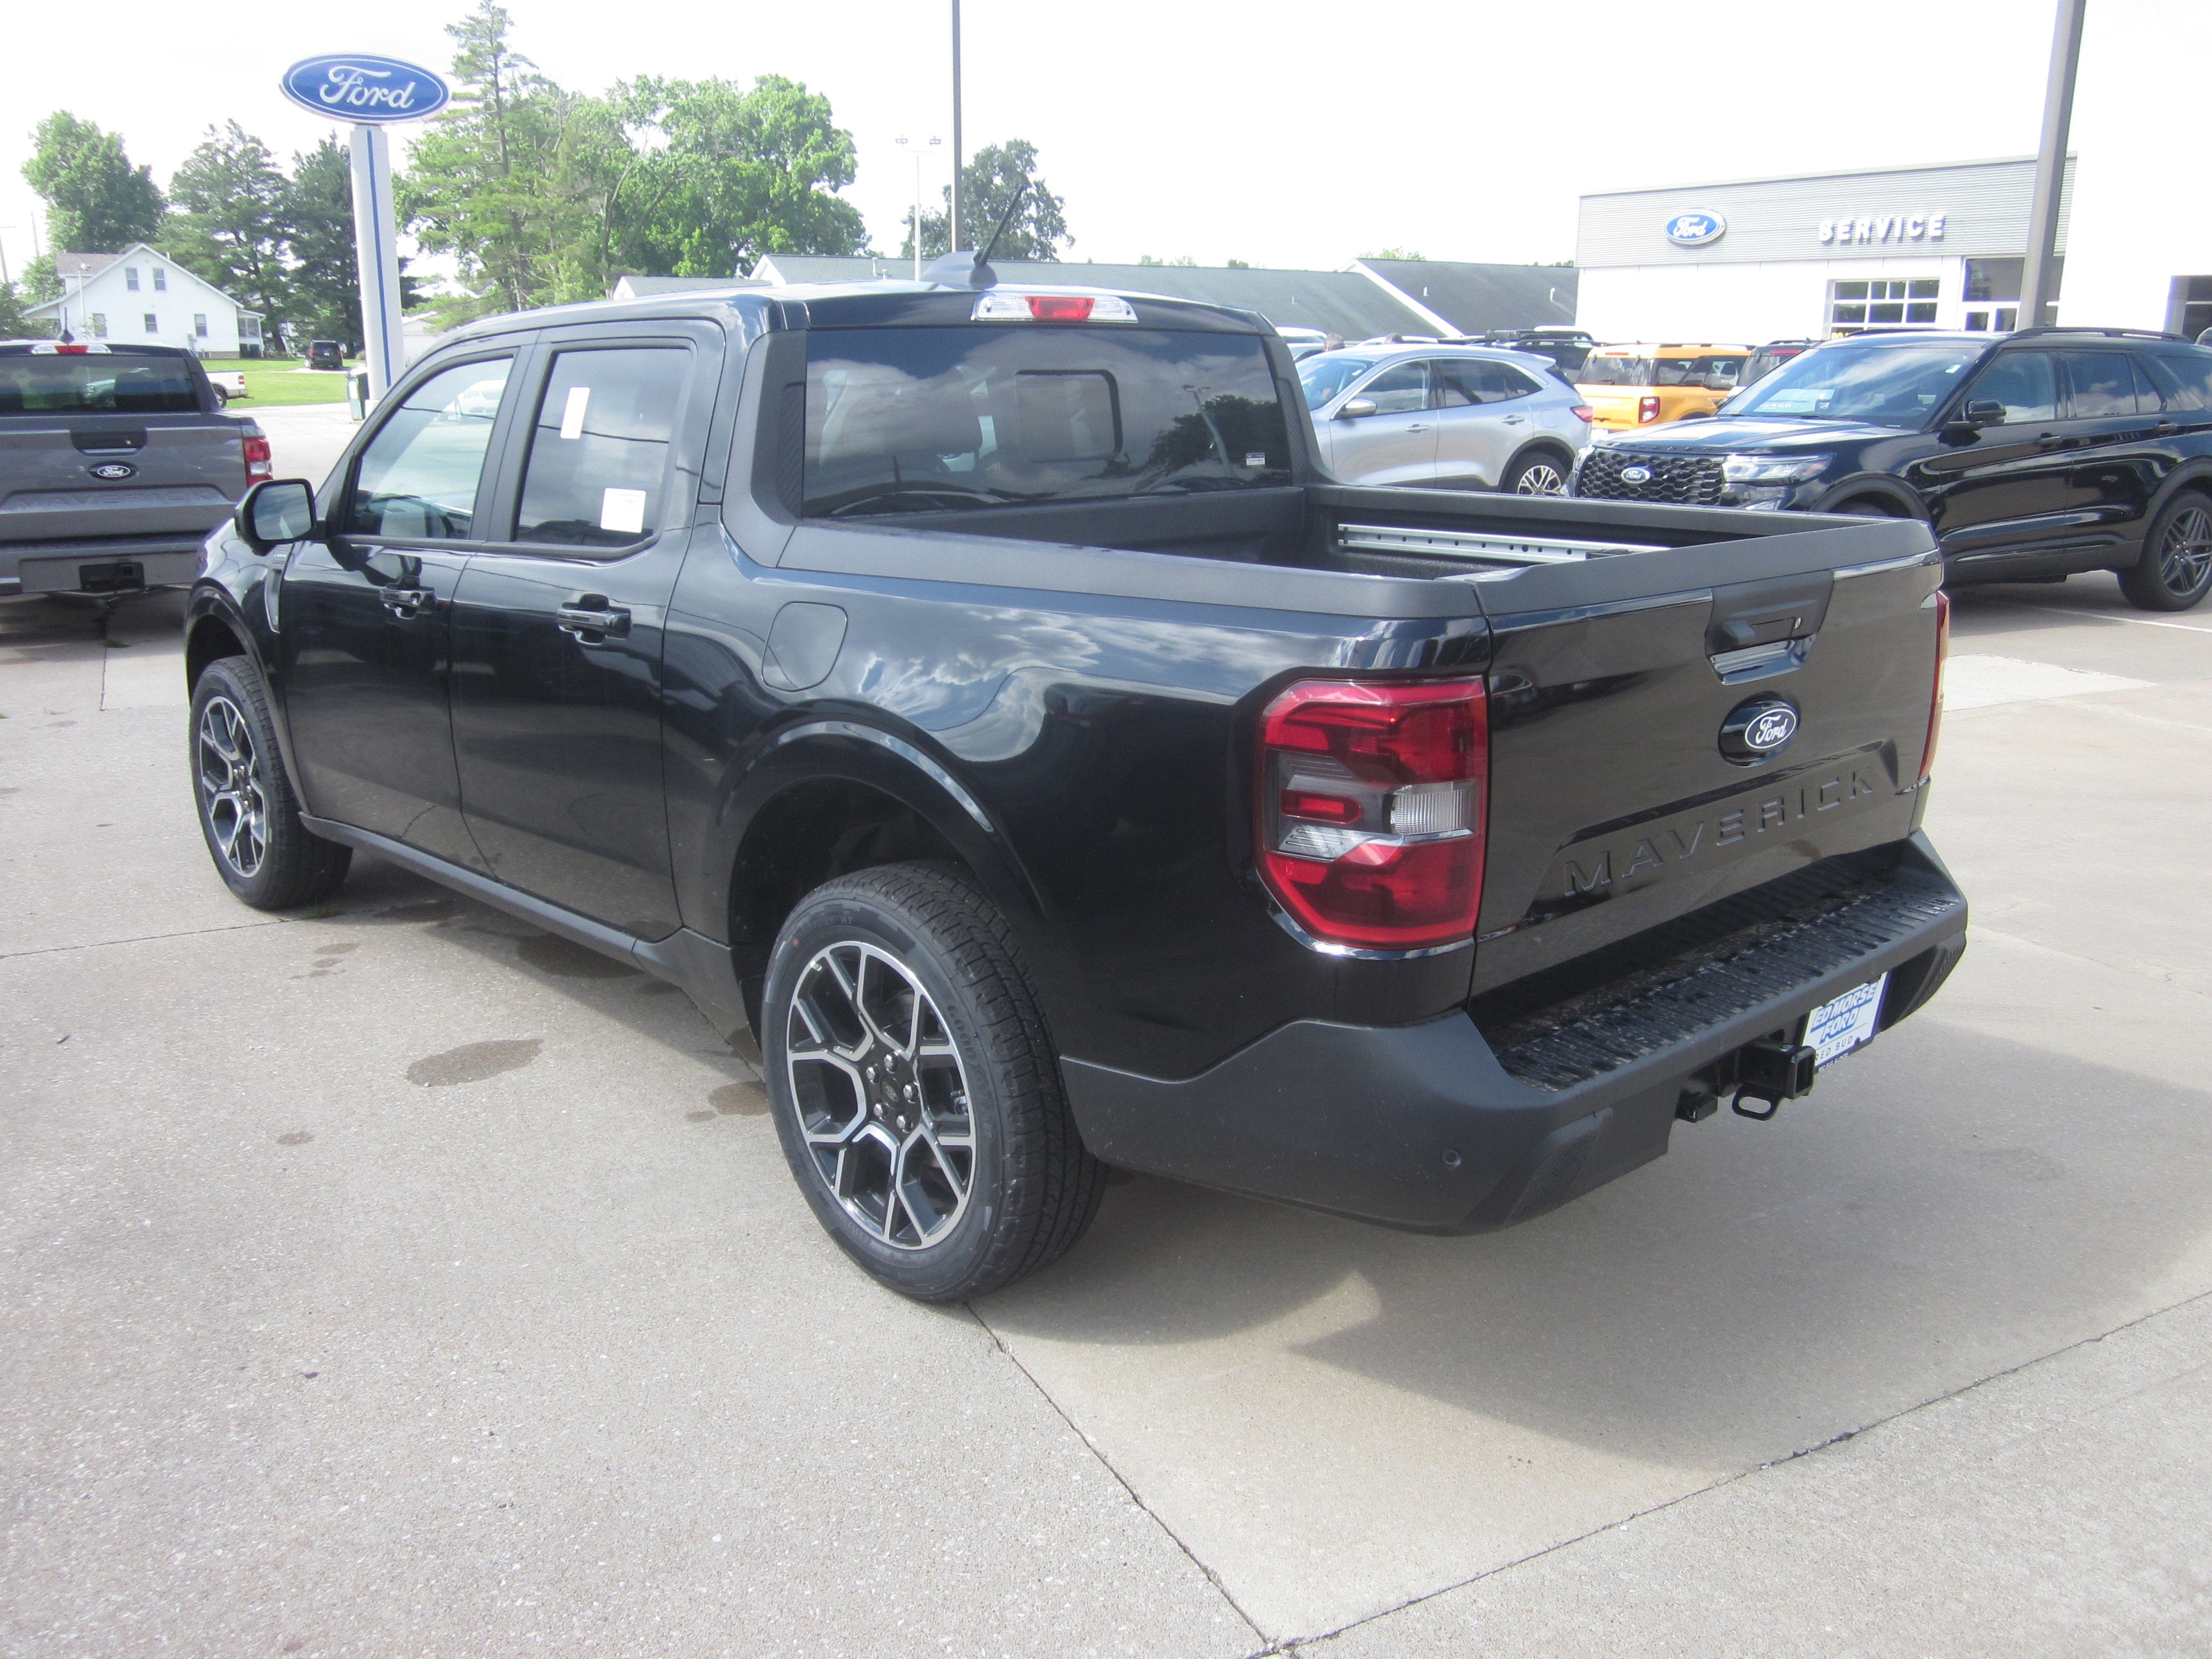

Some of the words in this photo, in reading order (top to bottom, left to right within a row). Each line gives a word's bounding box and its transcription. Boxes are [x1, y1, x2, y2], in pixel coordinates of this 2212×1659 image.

[319, 65, 416, 109] Ford
[1673, 216, 1708, 237] Ford
[1818, 212, 1945, 242] SERVICE
[1755, 714, 1788, 744] Ford
[1564, 771, 1873, 898] MAVERICK
[1811, 1003, 1834, 1032] ED
[1829, 981, 1877, 1019] MORSE
[1819, 1006, 1861, 1044] FORD
[1815, 1047, 1832, 1062] RED
[1835, 1035, 1853, 1051] BUD
